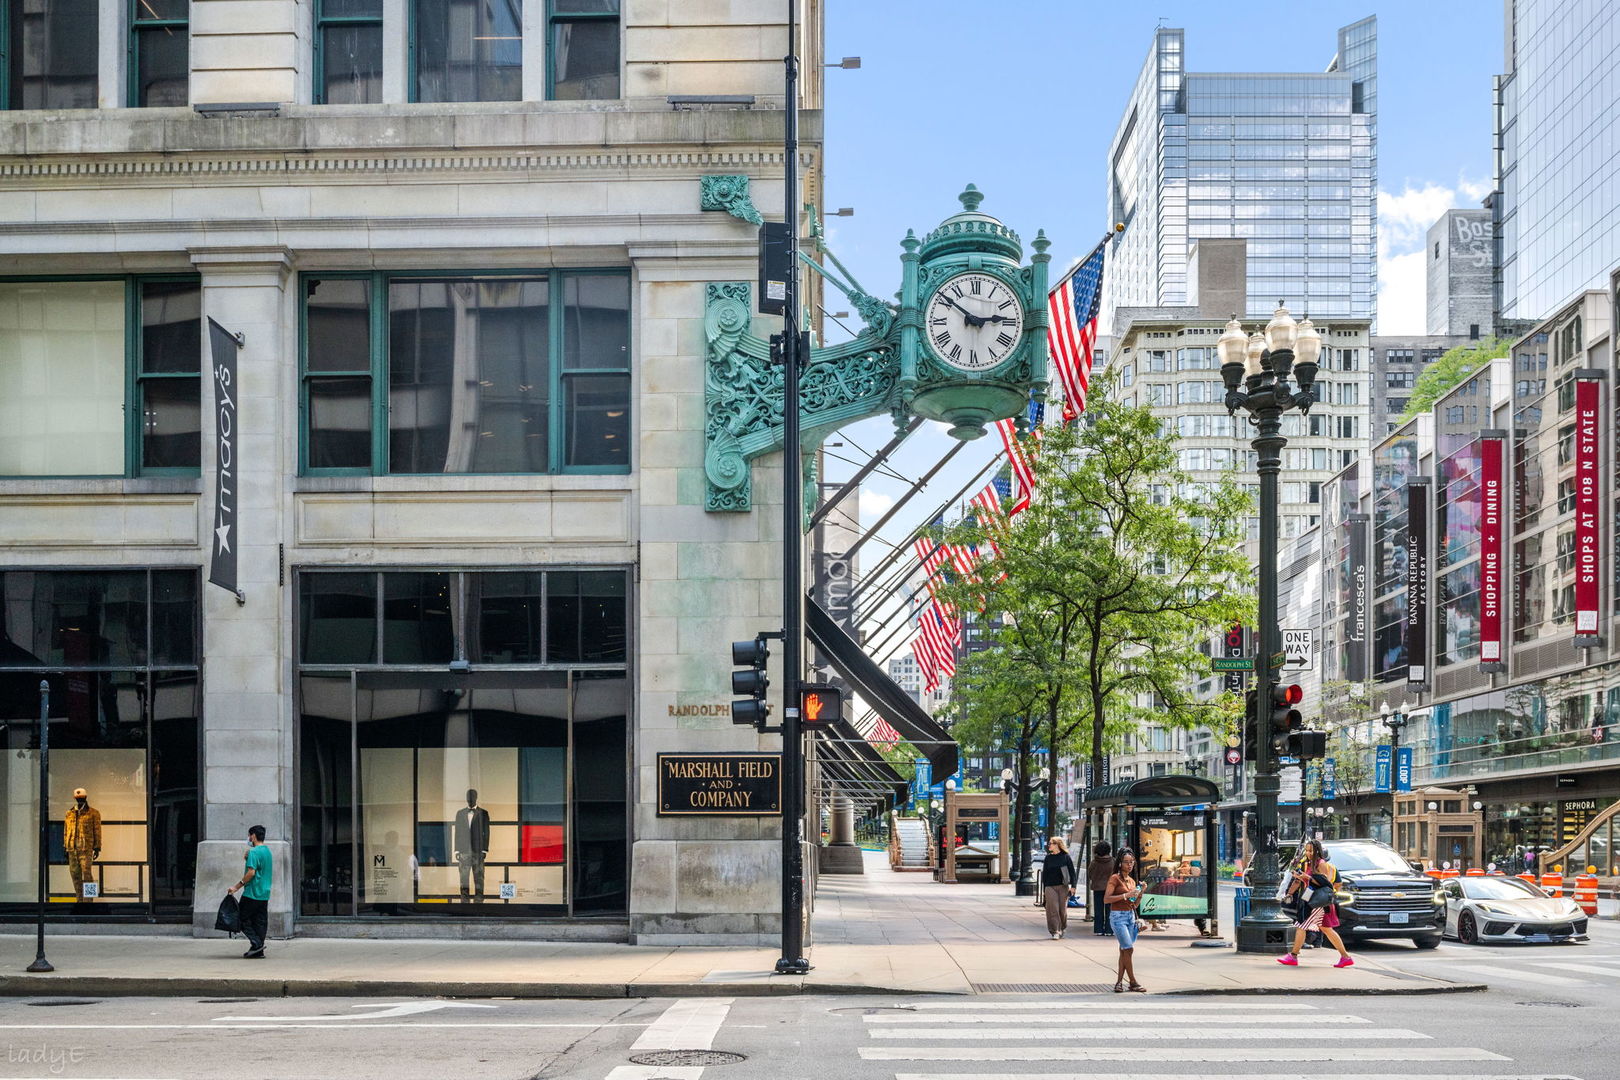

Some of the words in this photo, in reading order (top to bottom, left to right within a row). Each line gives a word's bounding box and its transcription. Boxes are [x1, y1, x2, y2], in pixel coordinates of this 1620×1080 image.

[970, 280, 981, 295] XII
[998, 299, 1012, 311] II
[969, 349, 979, 364] VI
[987, 346, 998, 360] V
[1582, 409, 1594, 454] STATE
[1583, 461, 1593, 470] N
[1582, 477, 1593, 503] 108
[1487, 479, 1498, 525] DINING
[1582, 512, 1594, 528] AT
[1409, 535, 1418, 582] REPUBLIC
[1582, 536, 1594, 583] SHOPS
[1486, 552, 1497, 617] SHOPPING
[1350, 564, 1365, 642] francesca's
[1409, 584, 1418, 625] BANANA
[1286, 633, 1309, 643] ONE
[1286, 644, 1310, 654] WAY
[668, 704, 730, 716] RANDOLPH
[669, 762, 734, 778] MARSHALL
[738, 762, 773, 778] FIELD
[1400, 765, 1408, 784] LOOP
[709, 781, 734, 789] AND
[690, 791, 753, 807] COMPANY
[1565, 801, 1595, 811] SEPHORA
